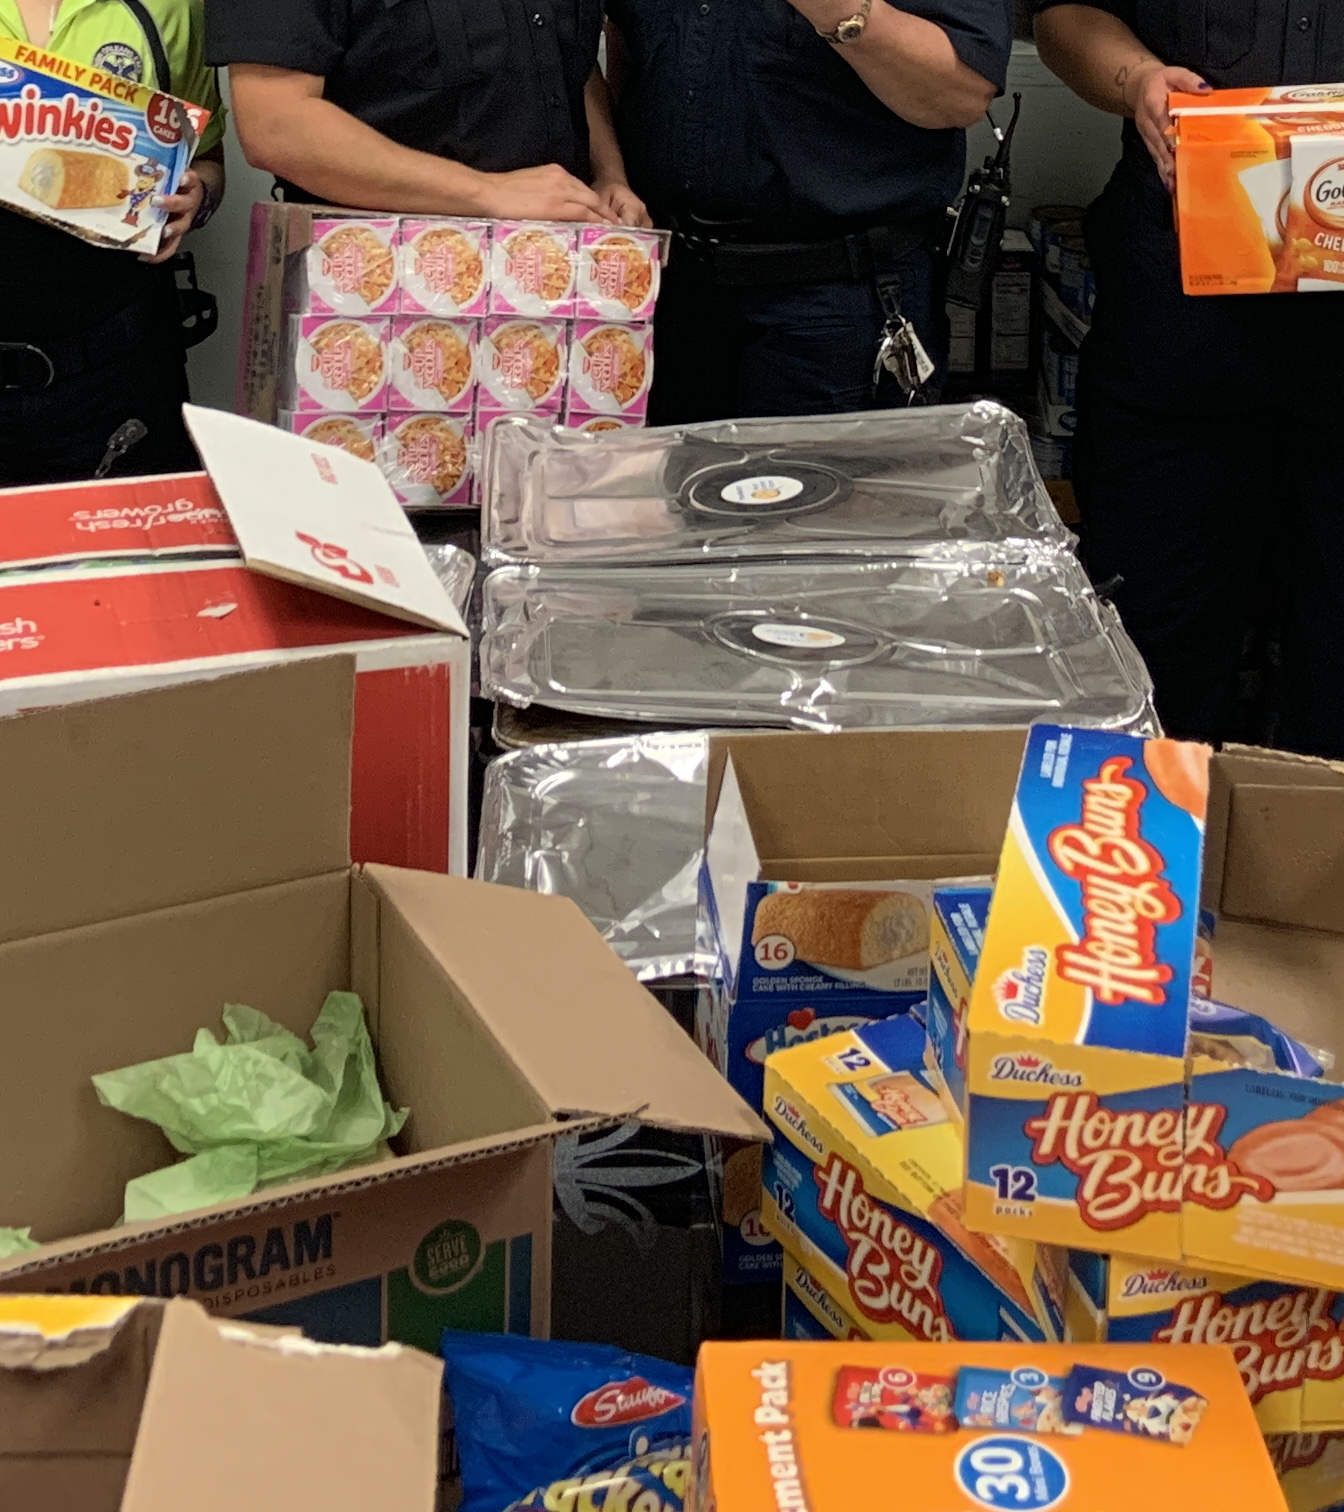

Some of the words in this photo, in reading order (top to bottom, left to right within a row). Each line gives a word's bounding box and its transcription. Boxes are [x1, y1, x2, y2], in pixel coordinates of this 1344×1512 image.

[15, 44, 87, 82] FAMILY
[88, 72, 139, 105] PACK
[331, 252, 342, 282] CUP
[424, 254, 435, 284] CUP
[514, 253, 526, 282] CUP
[598, 257, 609, 287] CUP
[320, 348, 332, 379] CUP
[413, 347, 424, 378] CUP
[501, 347, 513, 380] CUP
[591, 349, 602, 380] CUP
[72, 497, 194, 521] growers
[75, 506, 224, 534] uperfresh
[1053, 764, 1153, 876] Buns
[759, 941, 789, 962] 16
[1062, 873, 1167, 1003] Honey
[1004, 948, 1049, 1026] Duchess
[840, 1047, 872, 1073] 12
[992, 1055, 1084, 1089] Duchess
[772, 1094, 825, 1155] Duchess
[1031, 1093, 1212, 1165] Honey
[991, 1166, 1038, 1203] 12
[1083, 1146, 1260, 1220] Buns
[774, 1183, 797, 1224] 12
[994, 1204, 1035, 1218] packs
[817, 1158, 938, 1303] Honey
[68, 1212, 335, 1297] ONOGRAM
[425, 1232, 468, 1264] SERVE
[794, 1266, 845, 1329] Duchess
[846, 1231, 952, 1343] Buns
[1123, 1271, 1209, 1300] Duchess
[1157, 1287, 1330, 1345] Honey
[751, 1360, 790, 1425] Pack
[1019, 1371, 1040, 1383] 3
[969, 1446, 1032, 1502] 30
